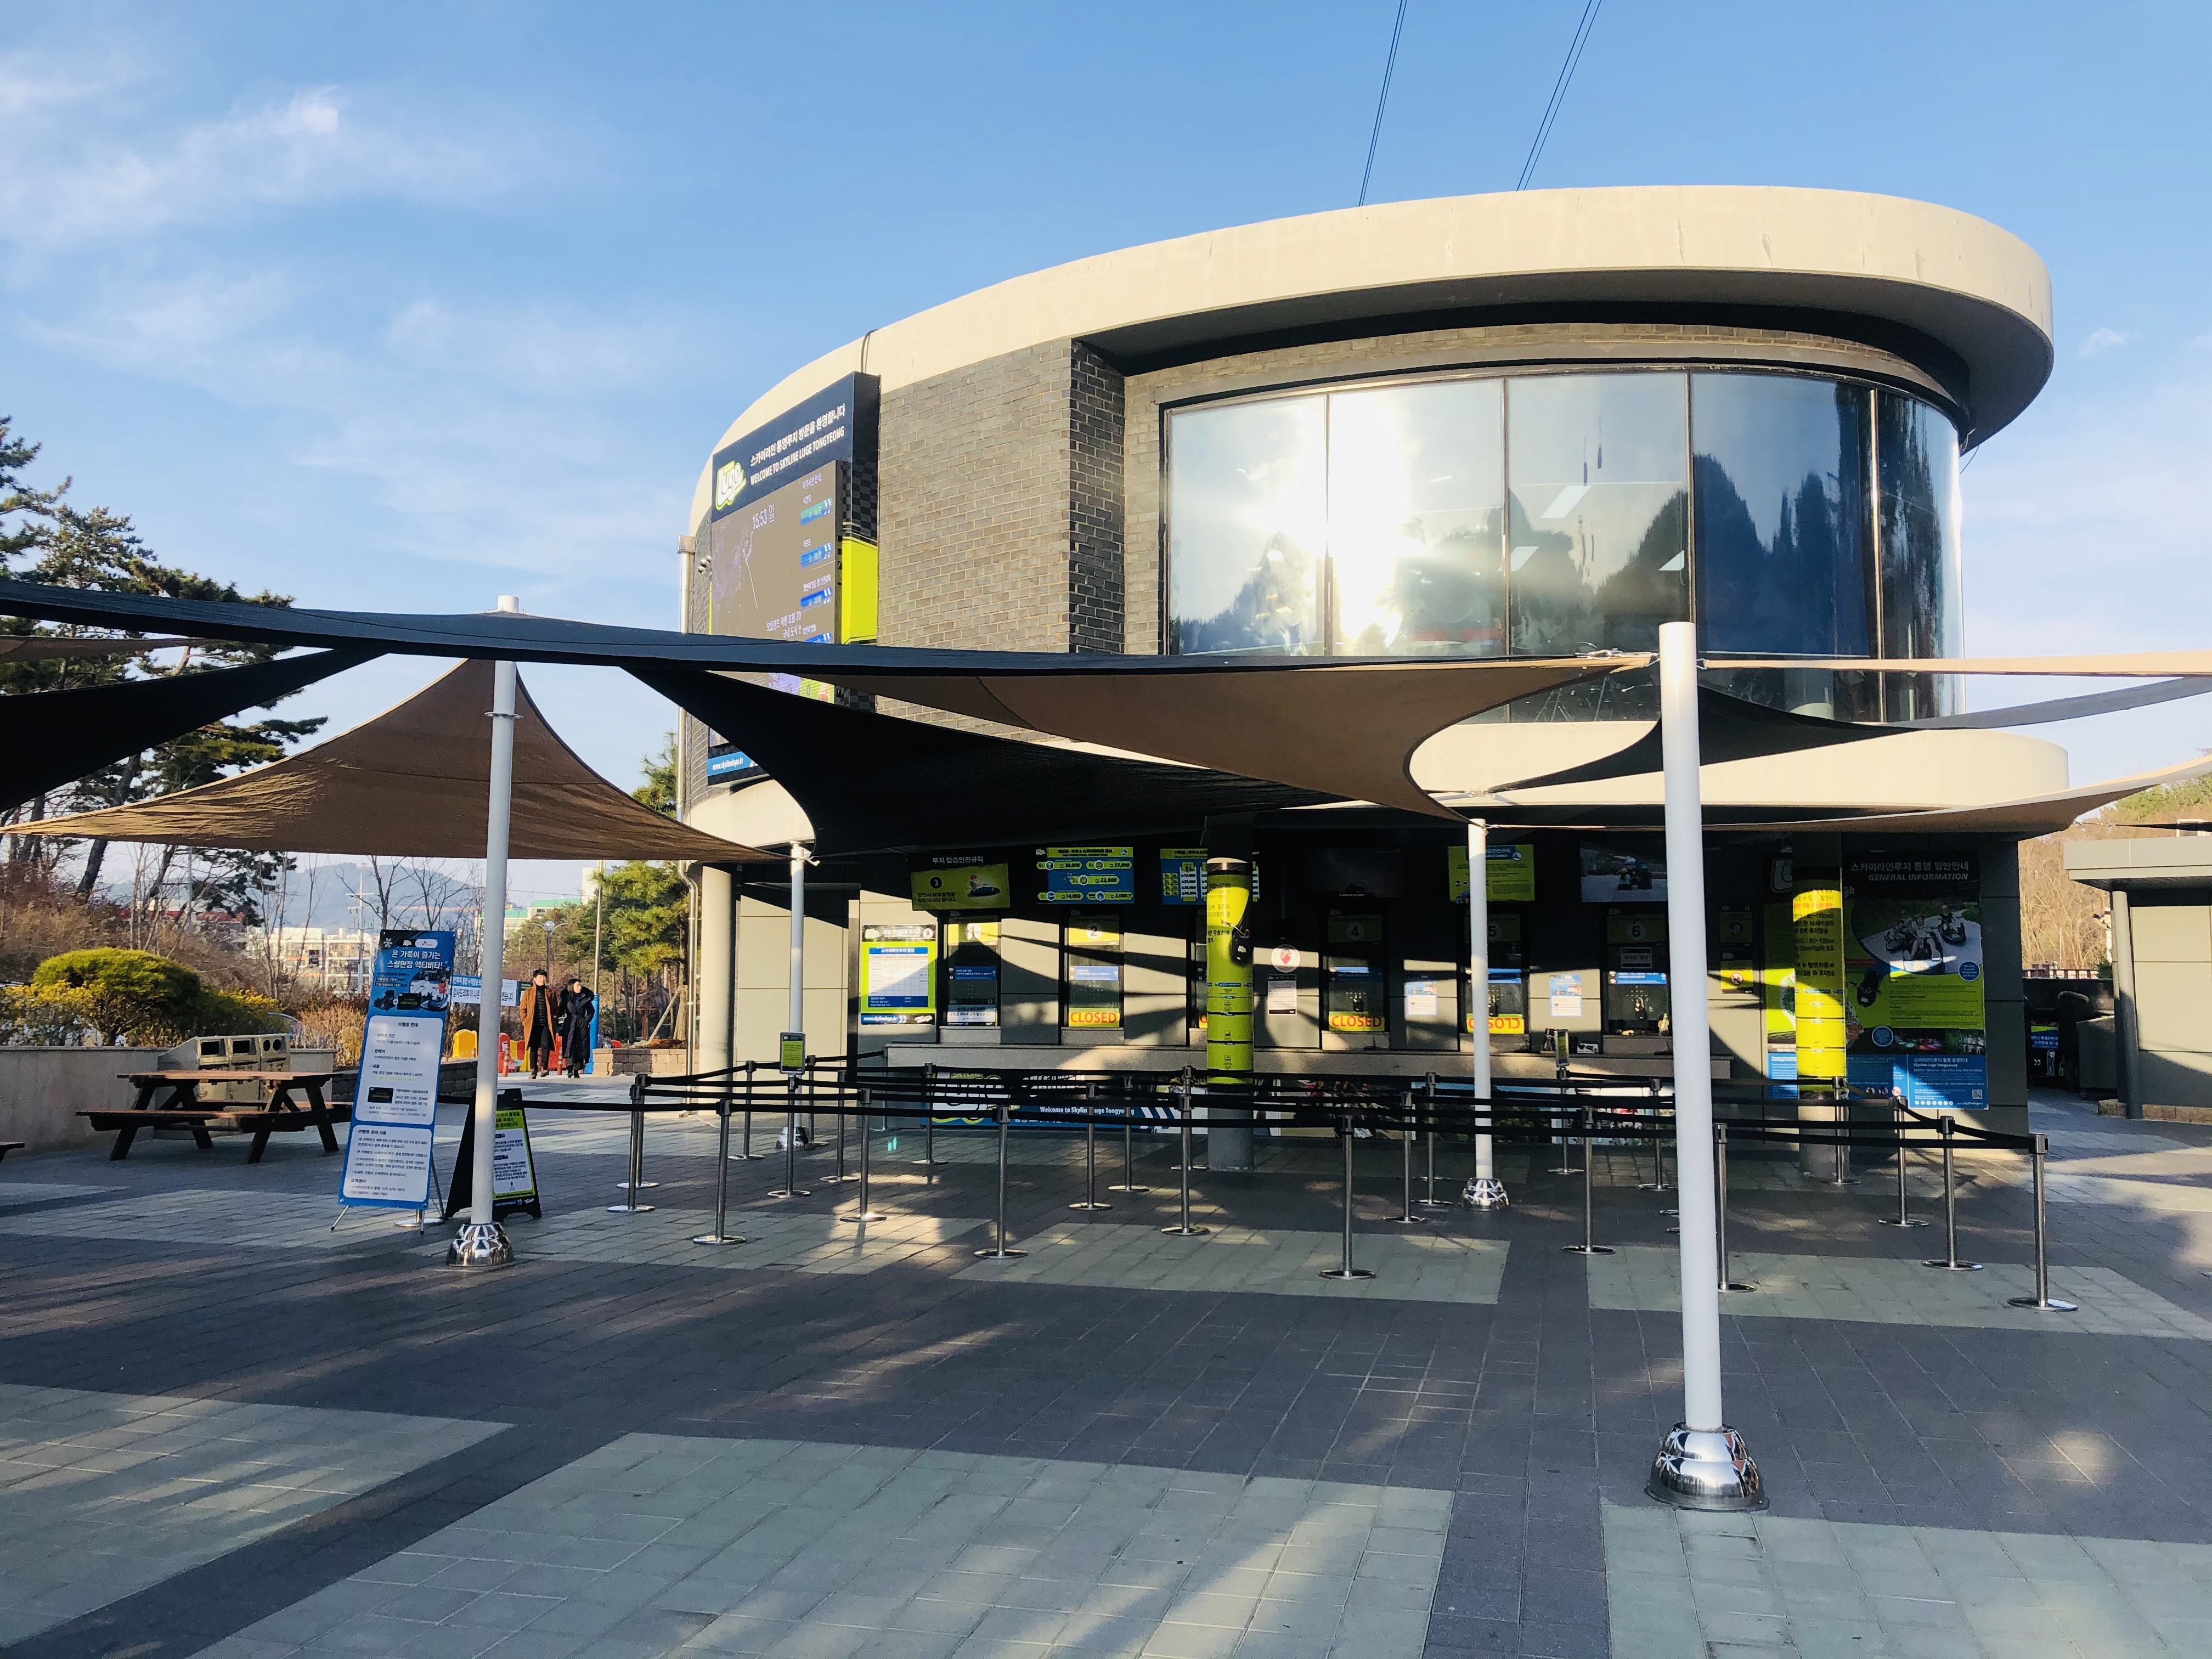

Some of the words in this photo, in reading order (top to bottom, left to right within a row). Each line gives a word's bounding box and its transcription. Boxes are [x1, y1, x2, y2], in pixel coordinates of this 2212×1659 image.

[749, 442, 776, 467] 스카이라인
[776, 430, 798, 453] 통영루지
[798, 420, 816, 441] 방문을
[816, 403, 846, 431] 환영합니다
[750, 463, 772, 486] WELCOME
[772, 461, 780, 473] TO
[779, 450, 799, 470] SKYLINE
[799, 444, 812, 462] LUGE
[812, 425, 845, 453] TONGYEONG
[752, 508, 768, 530] 15:53
[769, 502, 775, 524] 일
[795, 610, 802, 621] 20
[790, 624, 798, 637] 도시
[1850, 861, 1911, 871] 스카이라인루지
[1914, 861, 1931, 871] 통영
[1934, 861, 1969, 871] 일반안내
[1908, 873, 1968, 881] INFORMATION
[1090, 925, 1098, 936] 2
[1351, 925, 1359, 937] 4
[1488, 926, 1497, 937] 5
[1632, 925, 1640, 938] 6
[400, 950, 420, 959] 가족이
[421, 951, 441, 960] 즐기는
[387, 960, 413, 969] 스릴만점
[415, 961, 443, 969] 액티비티!
[452, 988, 470, 998] 감사드리며
[1070, 1012, 1117, 1024] CLOSED
[1331, 1015, 1382, 1028] CLOSED
[1071, 1107, 1088, 1115] Skylin
[1105, 1107, 1135, 1116] Tongyeg
